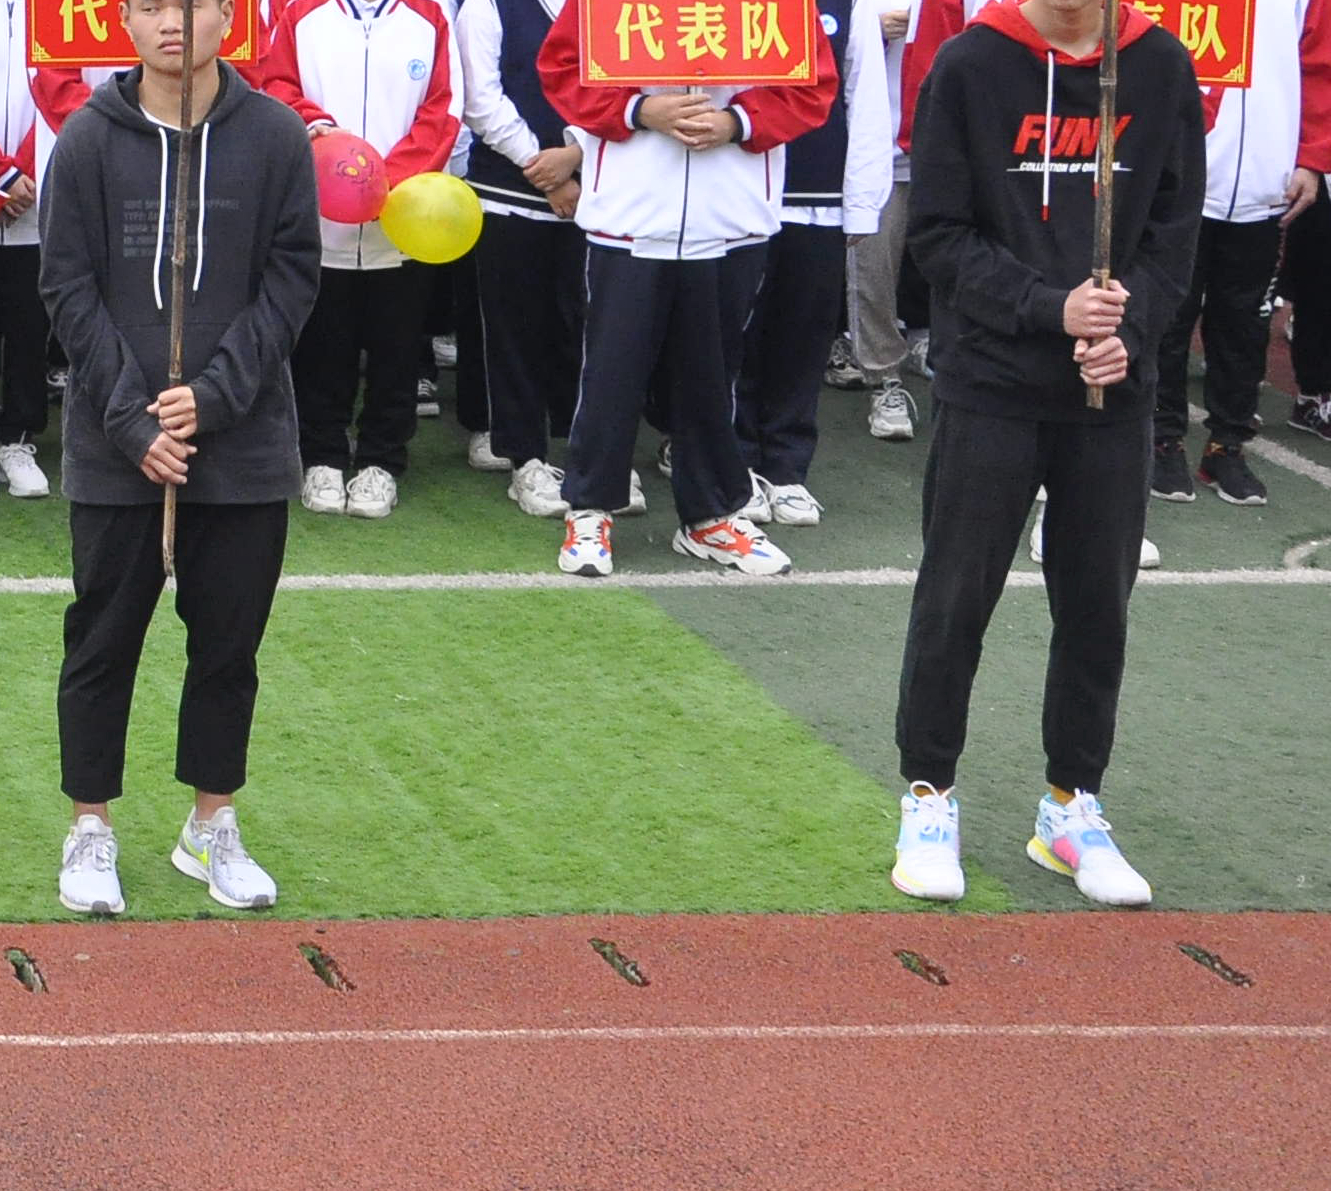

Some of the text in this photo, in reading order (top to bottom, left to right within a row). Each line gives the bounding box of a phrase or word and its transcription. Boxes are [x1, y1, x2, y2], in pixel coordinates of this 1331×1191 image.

[615, 1, 790, 61] 代表队
[1019, 161, 1068, 173] COLLETION
